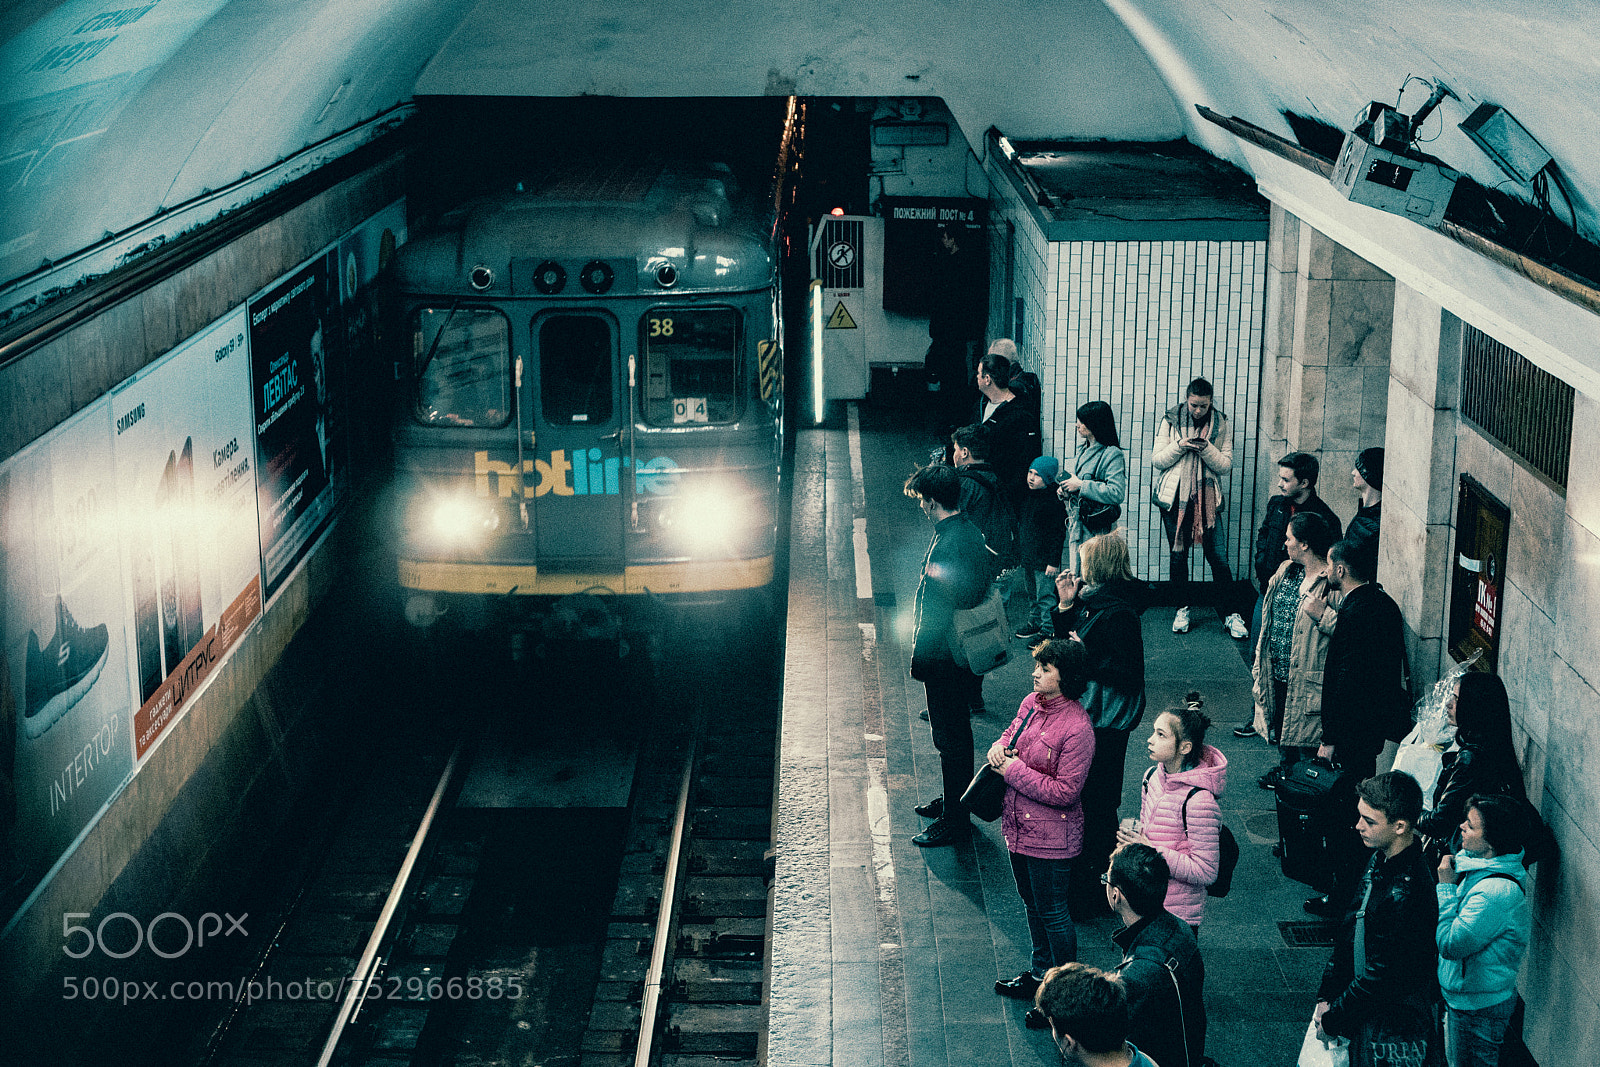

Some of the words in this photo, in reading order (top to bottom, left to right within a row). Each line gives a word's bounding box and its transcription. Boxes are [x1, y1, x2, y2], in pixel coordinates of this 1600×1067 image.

[21, 34, 120, 75] метро
[893, 206, 937, 220] ПОЖЕЖНИЙ
[939, 208, 959, 221] ПОСТ
[650, 318, 674, 337] 38
[116, 402, 146, 436] SAMSUNG
[212, 437, 240, 471] Камера.
[474, 447, 682, 499] hotline
[49, 713, 119, 817] INTERTOP
